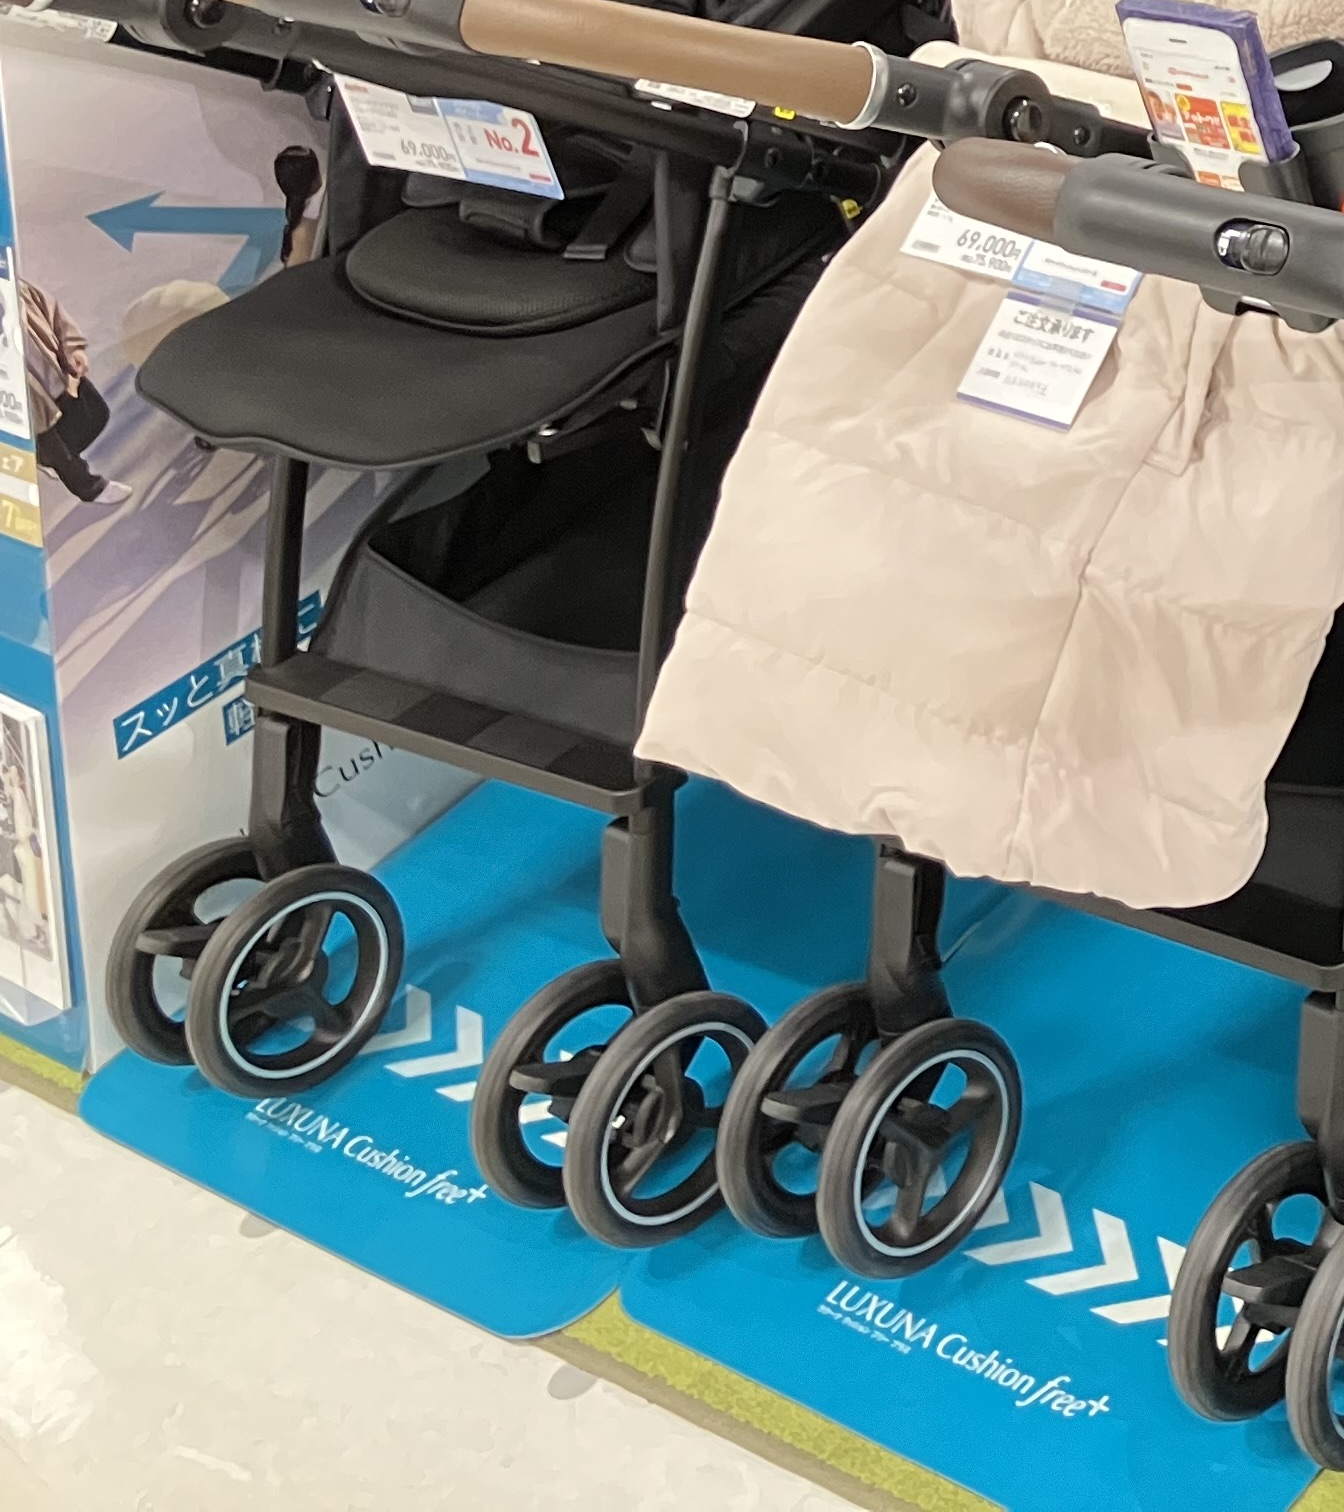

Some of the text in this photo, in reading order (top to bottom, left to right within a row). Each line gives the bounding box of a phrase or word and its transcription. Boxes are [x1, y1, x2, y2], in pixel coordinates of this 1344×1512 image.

[483, 117, 540, 158] No.2
[255, 1097, 489, 1205] LUXUNA Cushion free+
[825, 1279, 1111, 1417] LUXUNA Cushion free+
